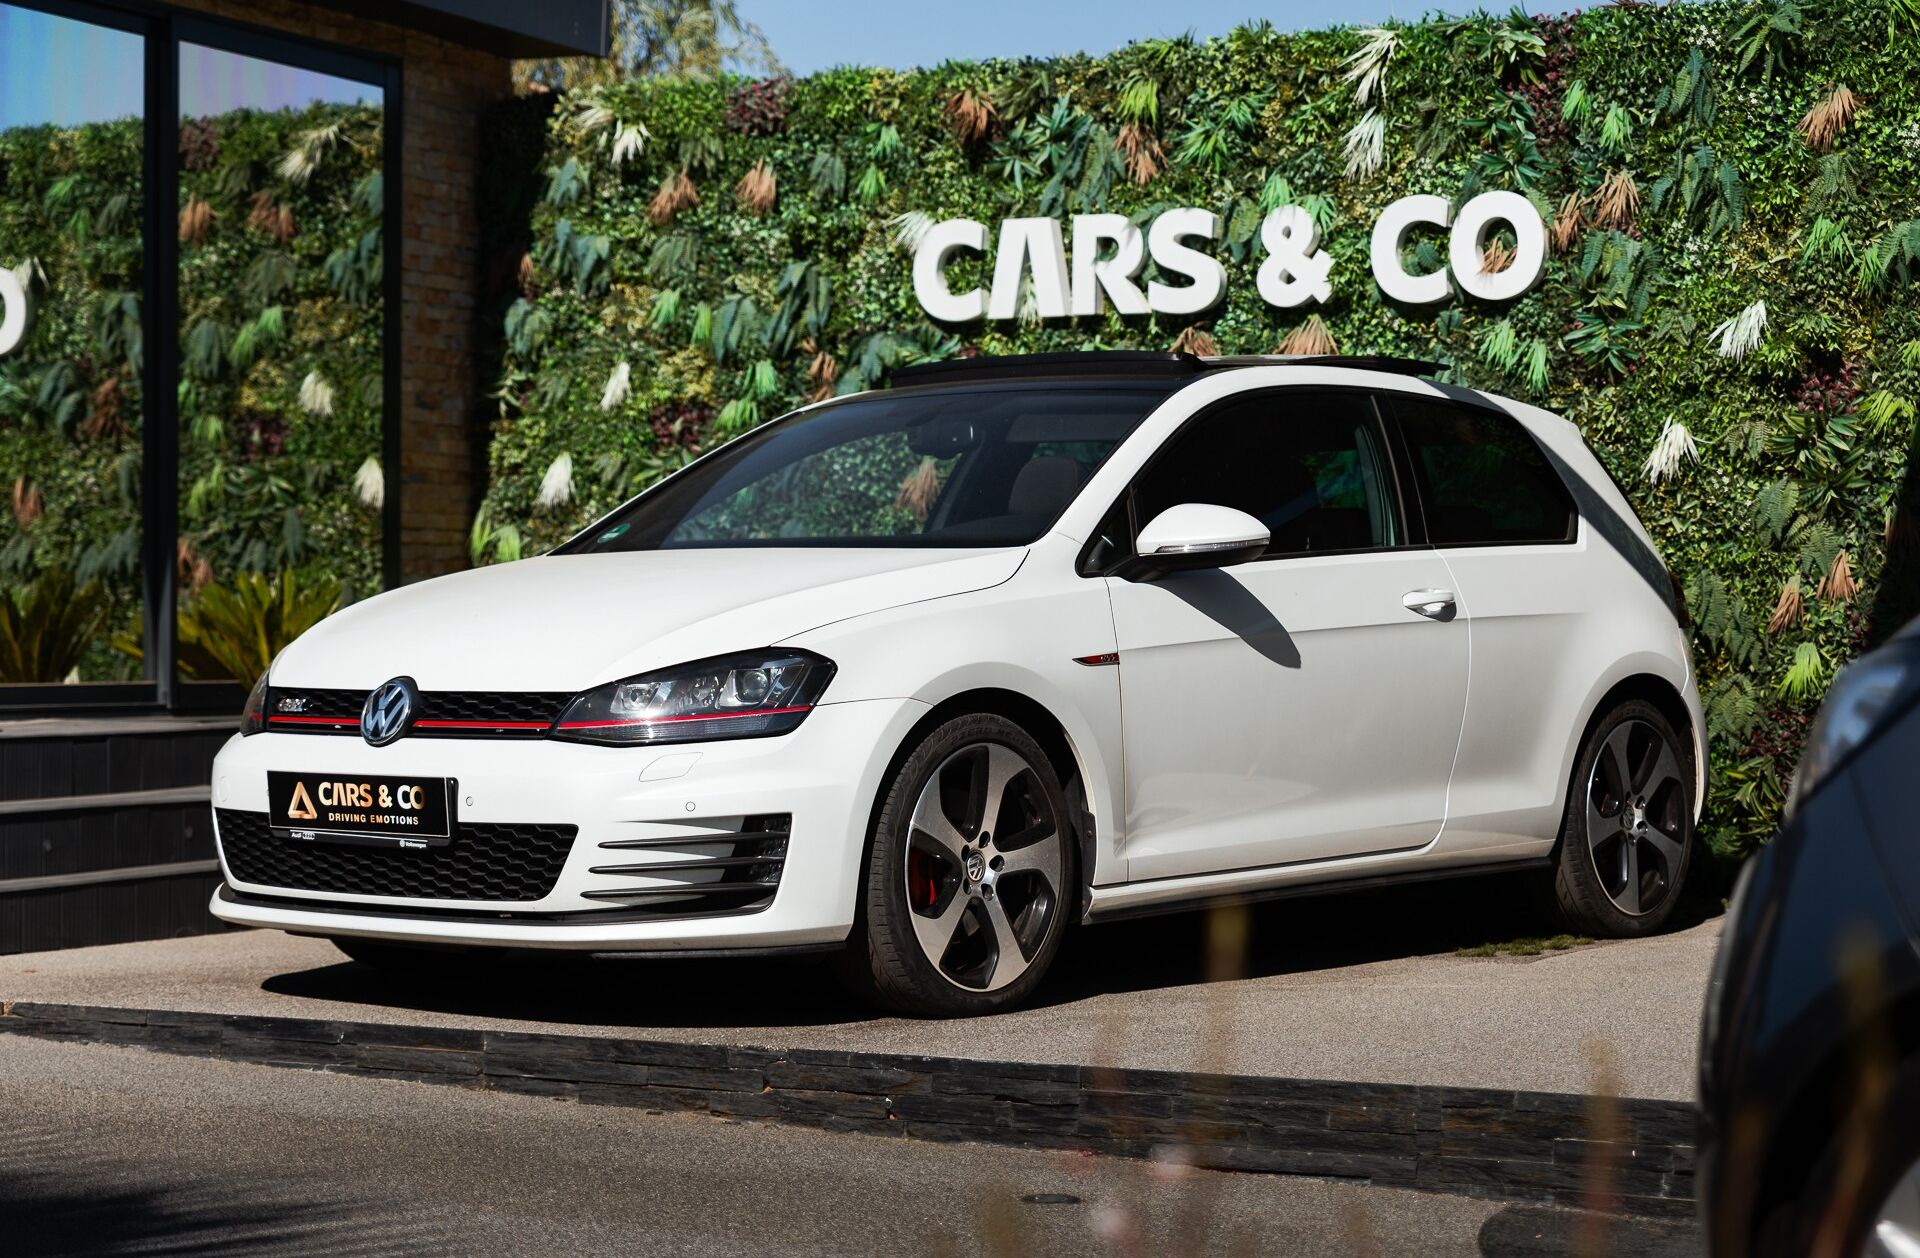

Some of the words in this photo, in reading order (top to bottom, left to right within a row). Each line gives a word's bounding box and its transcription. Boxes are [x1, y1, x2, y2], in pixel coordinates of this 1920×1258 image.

[912, 207, 1228, 323] CARS
[1256, 205, 1336, 308] &
[1371, 190, 1549, 304] CO
[318, 781, 373, 808] CARS
[378, 784, 393, 809] &
[397, 784, 425, 810] CO
[328, 812, 366, 823] DRIVING
[370, 814, 419, 825] EMOTIONS
